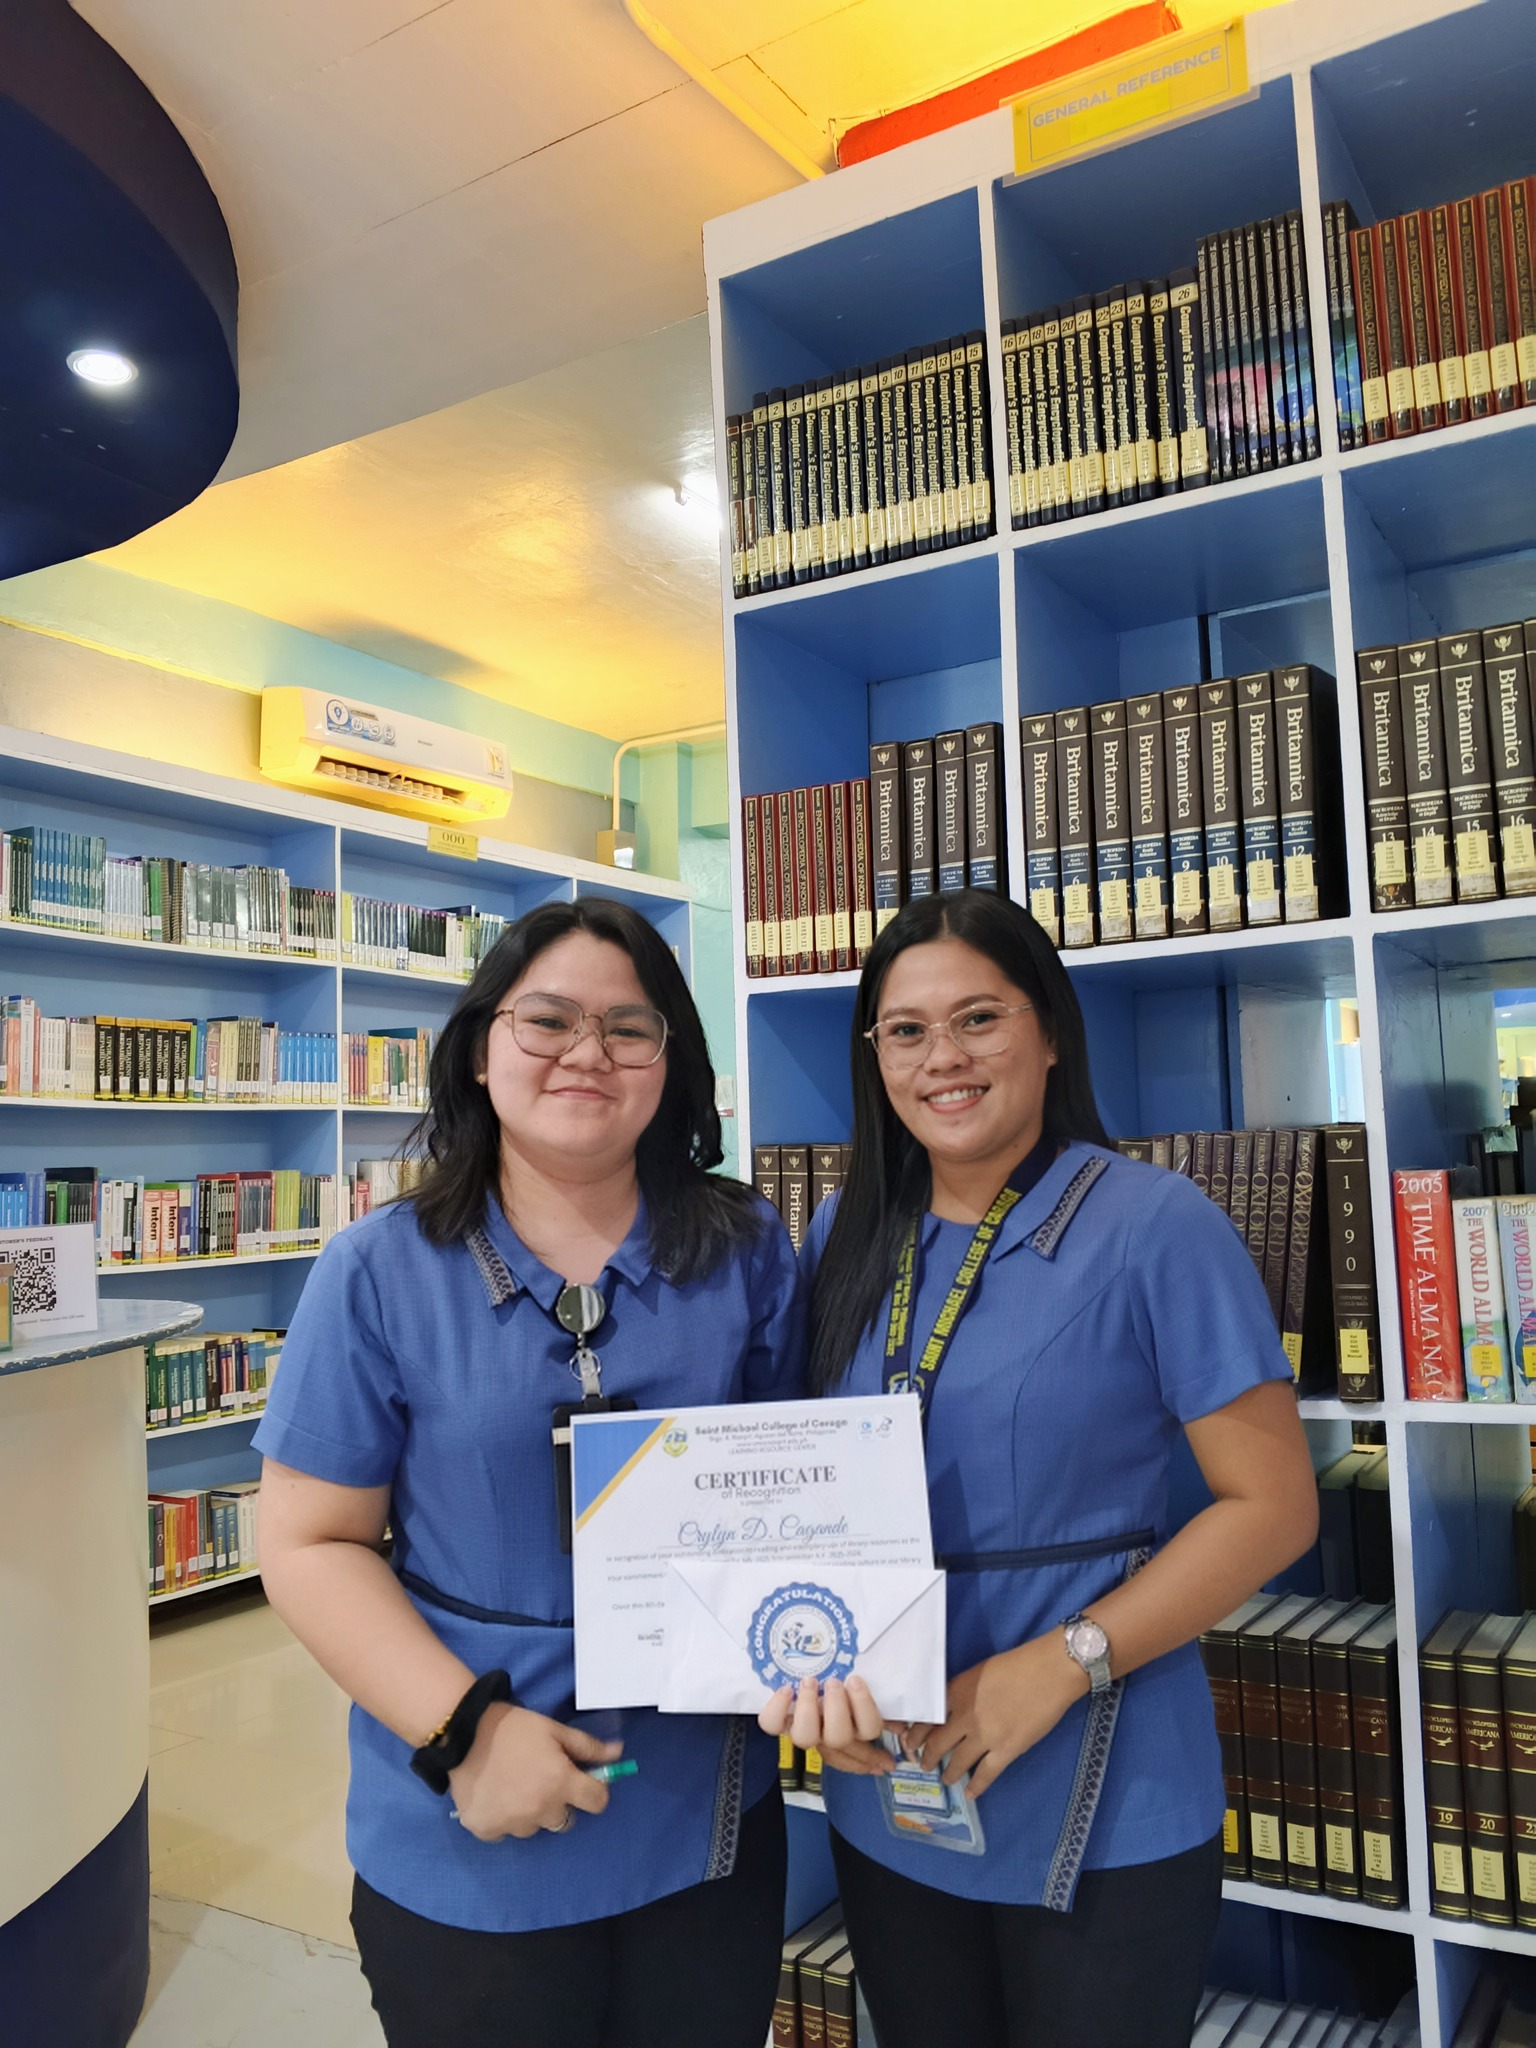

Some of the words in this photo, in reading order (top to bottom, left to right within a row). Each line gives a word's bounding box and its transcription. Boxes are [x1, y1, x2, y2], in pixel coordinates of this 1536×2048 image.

[1033, 90, 1112, 128] GENERAL
[1116, 45, 1221, 96] REFERENCE
[1178, 288, 1190, 300] 26
[1130, 298, 1142, 310] 24
[1152, 297, 1163, 309] 25
[1111, 304, 1122, 315] 23
[1062, 320, 1073, 332] 20
[1078, 315, 1088, 326] 21
[1032, 330, 1041, 340] 18
[1046, 325, 1056, 334] 19
[1004, 338, 1014, 348] 16
[1018, 334, 1027, 345] 17
[953, 351, 962, 362] 14
[969, 347, 978, 358] 15
[925, 360, 934, 371] 12
[939, 356, 948, 367] 13
[894, 369, 903, 380] 10
[912, 365, 919, 375] 11
[1455, 674, 1475, 775] Britannica
[1499, 668, 1520, 769] Britannica
[1413, 682, 1433, 782] Britannica
[1373, 690, 1392, 787] Britannica
[1249, 712, 1267, 807] Britannica
[1286, 706, 1305, 802] Britannica
[1175, 725, 1192, 819] Britannica
[1211, 719, 1228, 813] Britannica
[1103, 740, 1120, 830] Britannica
[1139, 733, 1157, 825] Britannica
[1033, 752, 1049, 841] Britannica
[1066, 746, 1082, 835] Britannica
[944, 768, 957, 853] Britannica
[975, 761, 988, 848] Britannica
[878, 779, 893, 862] Britannica
[913, 776, 926, 860] Britannica
[1510, 814, 1525, 826] 16
[1422, 826, 1435, 837] 14
[1466, 820, 1480, 832] 15
[1382, 832, 1394, 842] 13
[1256, 850, 1266, 861] 11
[1292, 846, 1305, 856] 12
[1182, 861, 1190, 872] 9
[1216, 856, 1228, 866] 10
[1110, 871, 1117, 881] 7
[1146, 866, 1153, 878] 8
[1039, 879, 1046, 889] 5
[1072, 875, 1080, 885] 6
[1398, 1177, 1443, 1194] 2005
[1248, 1172, 1269, 1257] OXFORD
[1268, 1172, 1290, 1257] OXFORD
[1291, 1172, 1313, 1257] OXFORD
[1462, 1207, 1488, 1216] 2007
[1467, 1218, 1483, 1227] THE
[1511, 1219, 1527, 1227] THE
[1410, 1198, 1436, 1264] TIME
[1468, 1227, 1490, 1293] WORLD
[1512, 1228, 1534, 1291] WORLD
[920, 1337, 945, 1371] SAINT
[934, 1287, 967, 1337] MICHAEL
[956, 1240, 989, 1286] COLLEGE
[976, 1223, 994, 1241] OF
[695, 1425, 719, 1435] Saint
[722, 1422, 759, 1434] Michael
[762, 1421, 797, 1434] College
[800, 1419, 809, 1429] of
[695, 1465, 837, 1490] CERTIFICATE
[722, 1488, 732, 1499] of
[736, 1487, 800, 1499] Recognition
[754, 1589, 851, 1660] CONGRATULATIONS!
[1439, 1812, 1453, 1824] 19
[1480, 1818, 1495, 1830] 20
